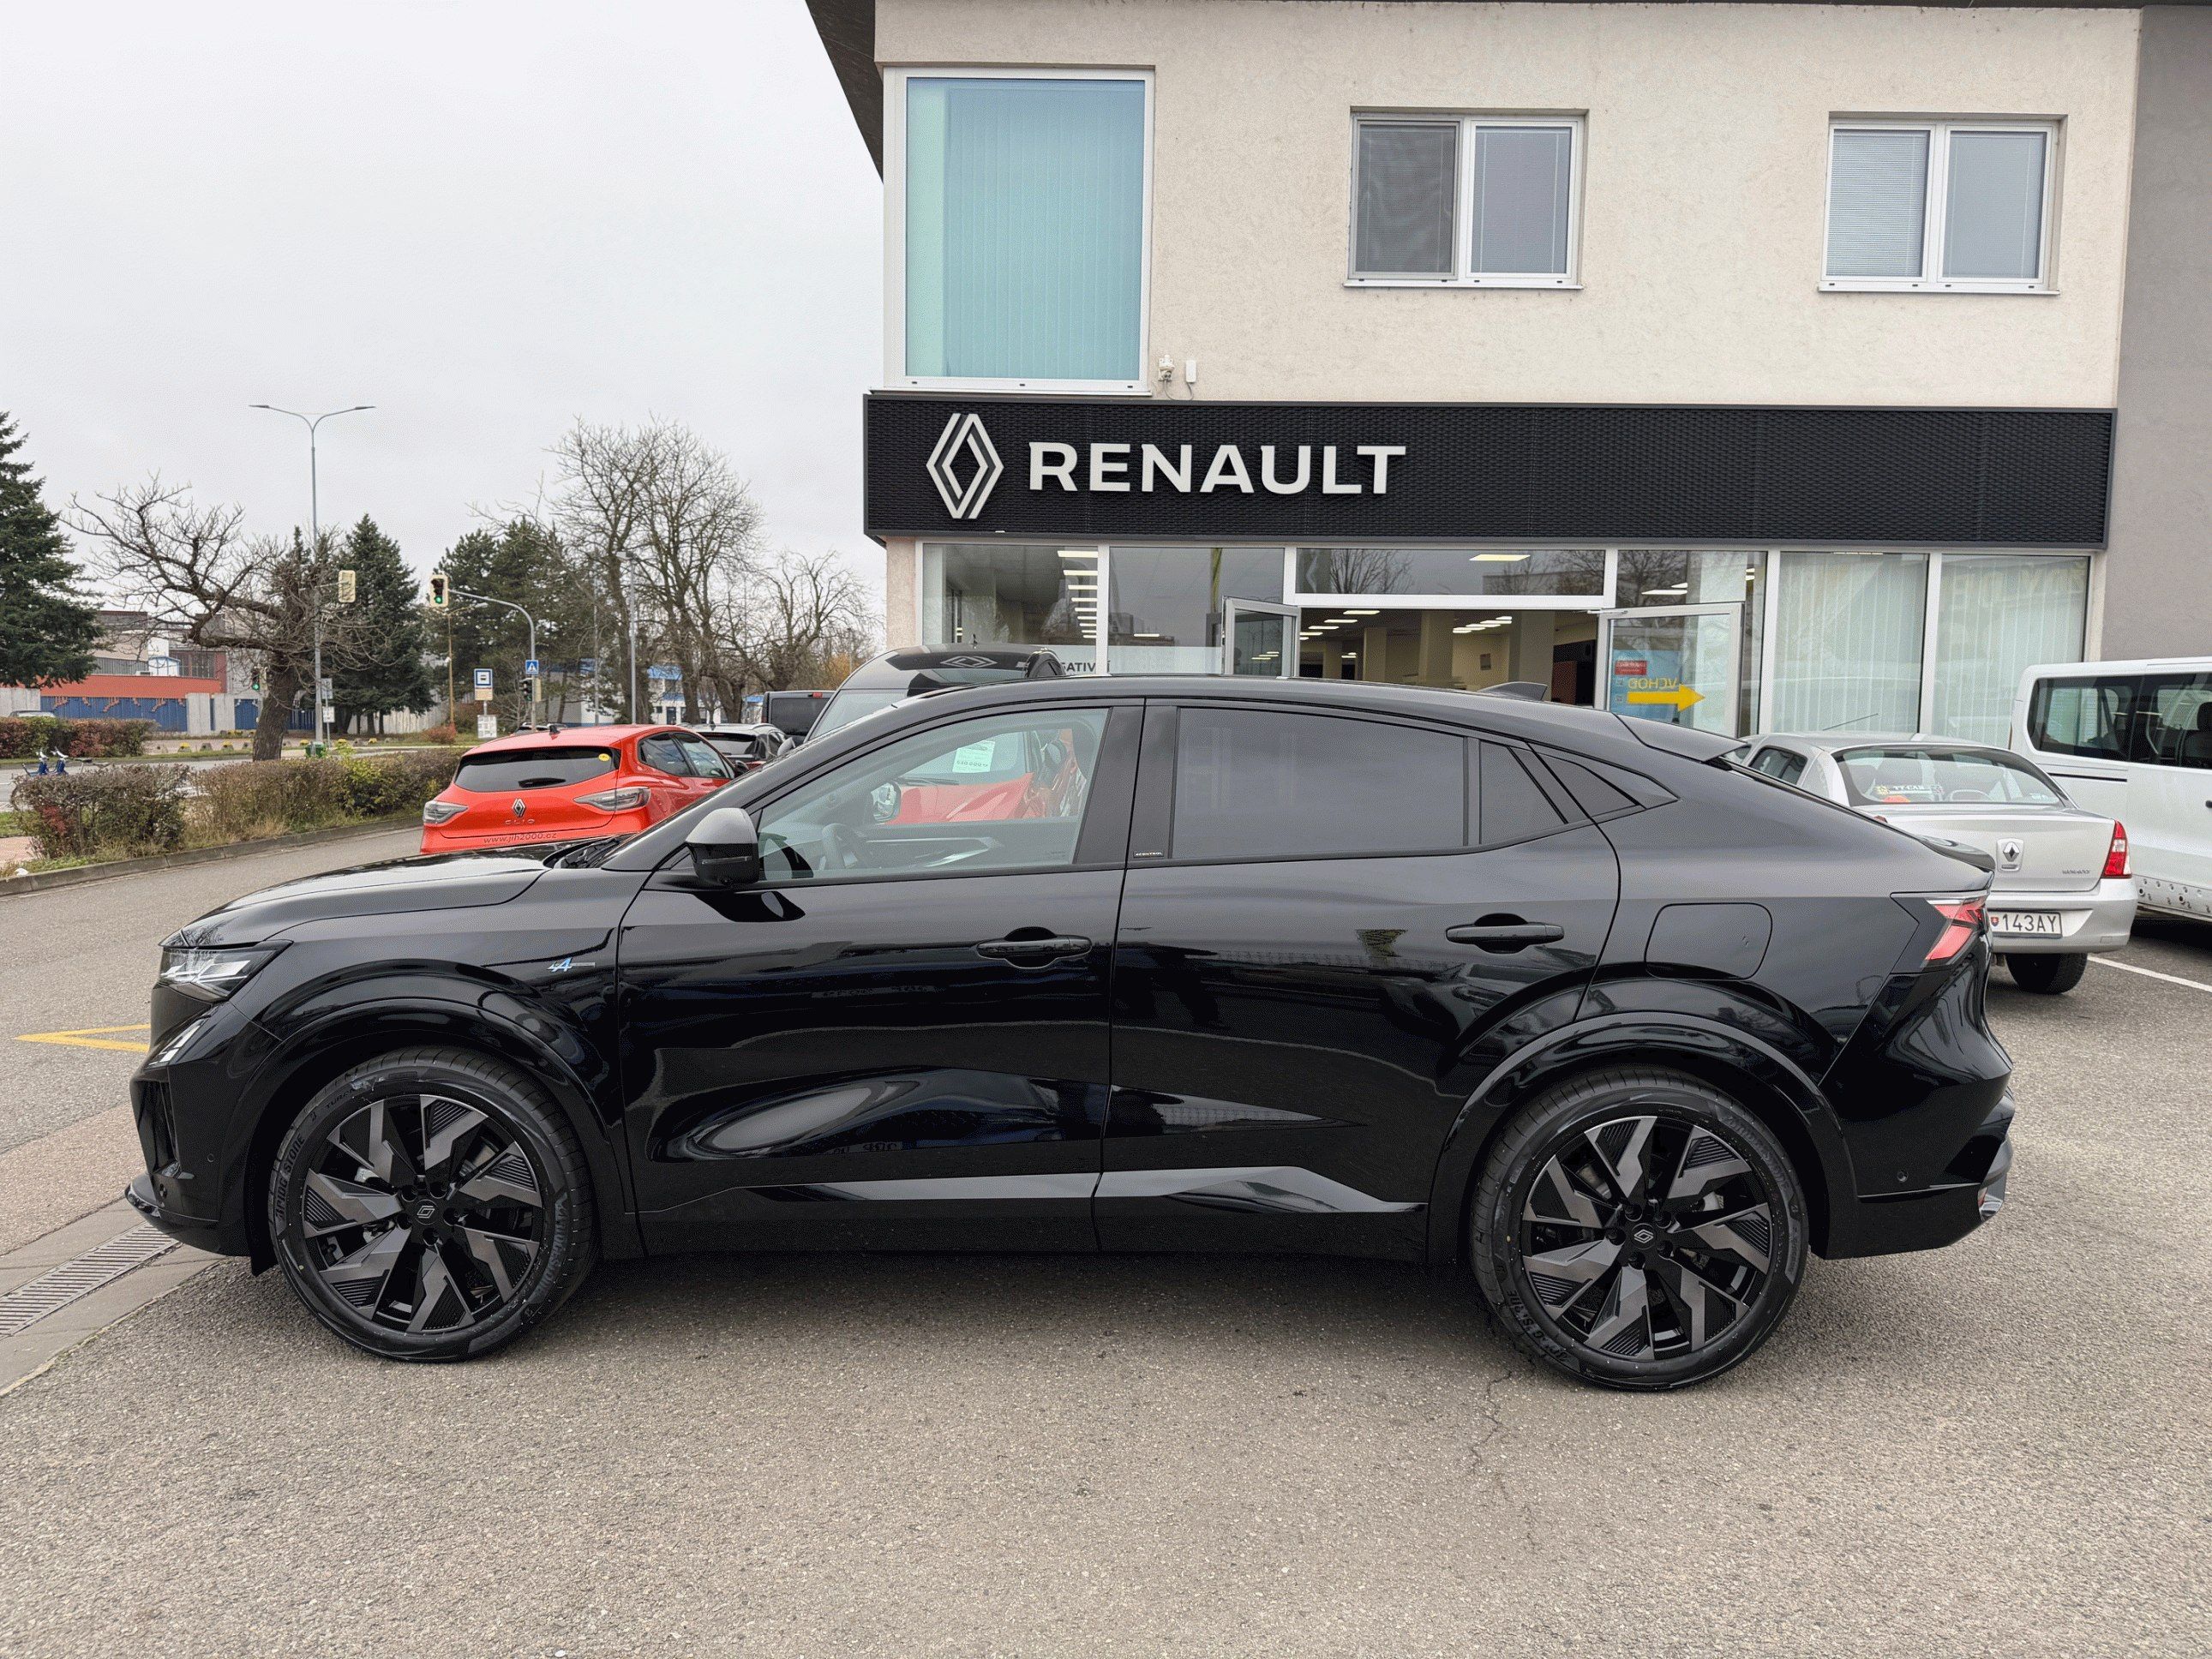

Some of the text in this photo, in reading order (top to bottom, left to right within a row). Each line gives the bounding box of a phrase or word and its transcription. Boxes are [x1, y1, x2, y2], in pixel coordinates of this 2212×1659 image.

[1028, 441, 1406, 494] RENAULT
[1061, 661, 1112, 673] ATIVÍ
[2002, 913, 2057, 932] 143AY
